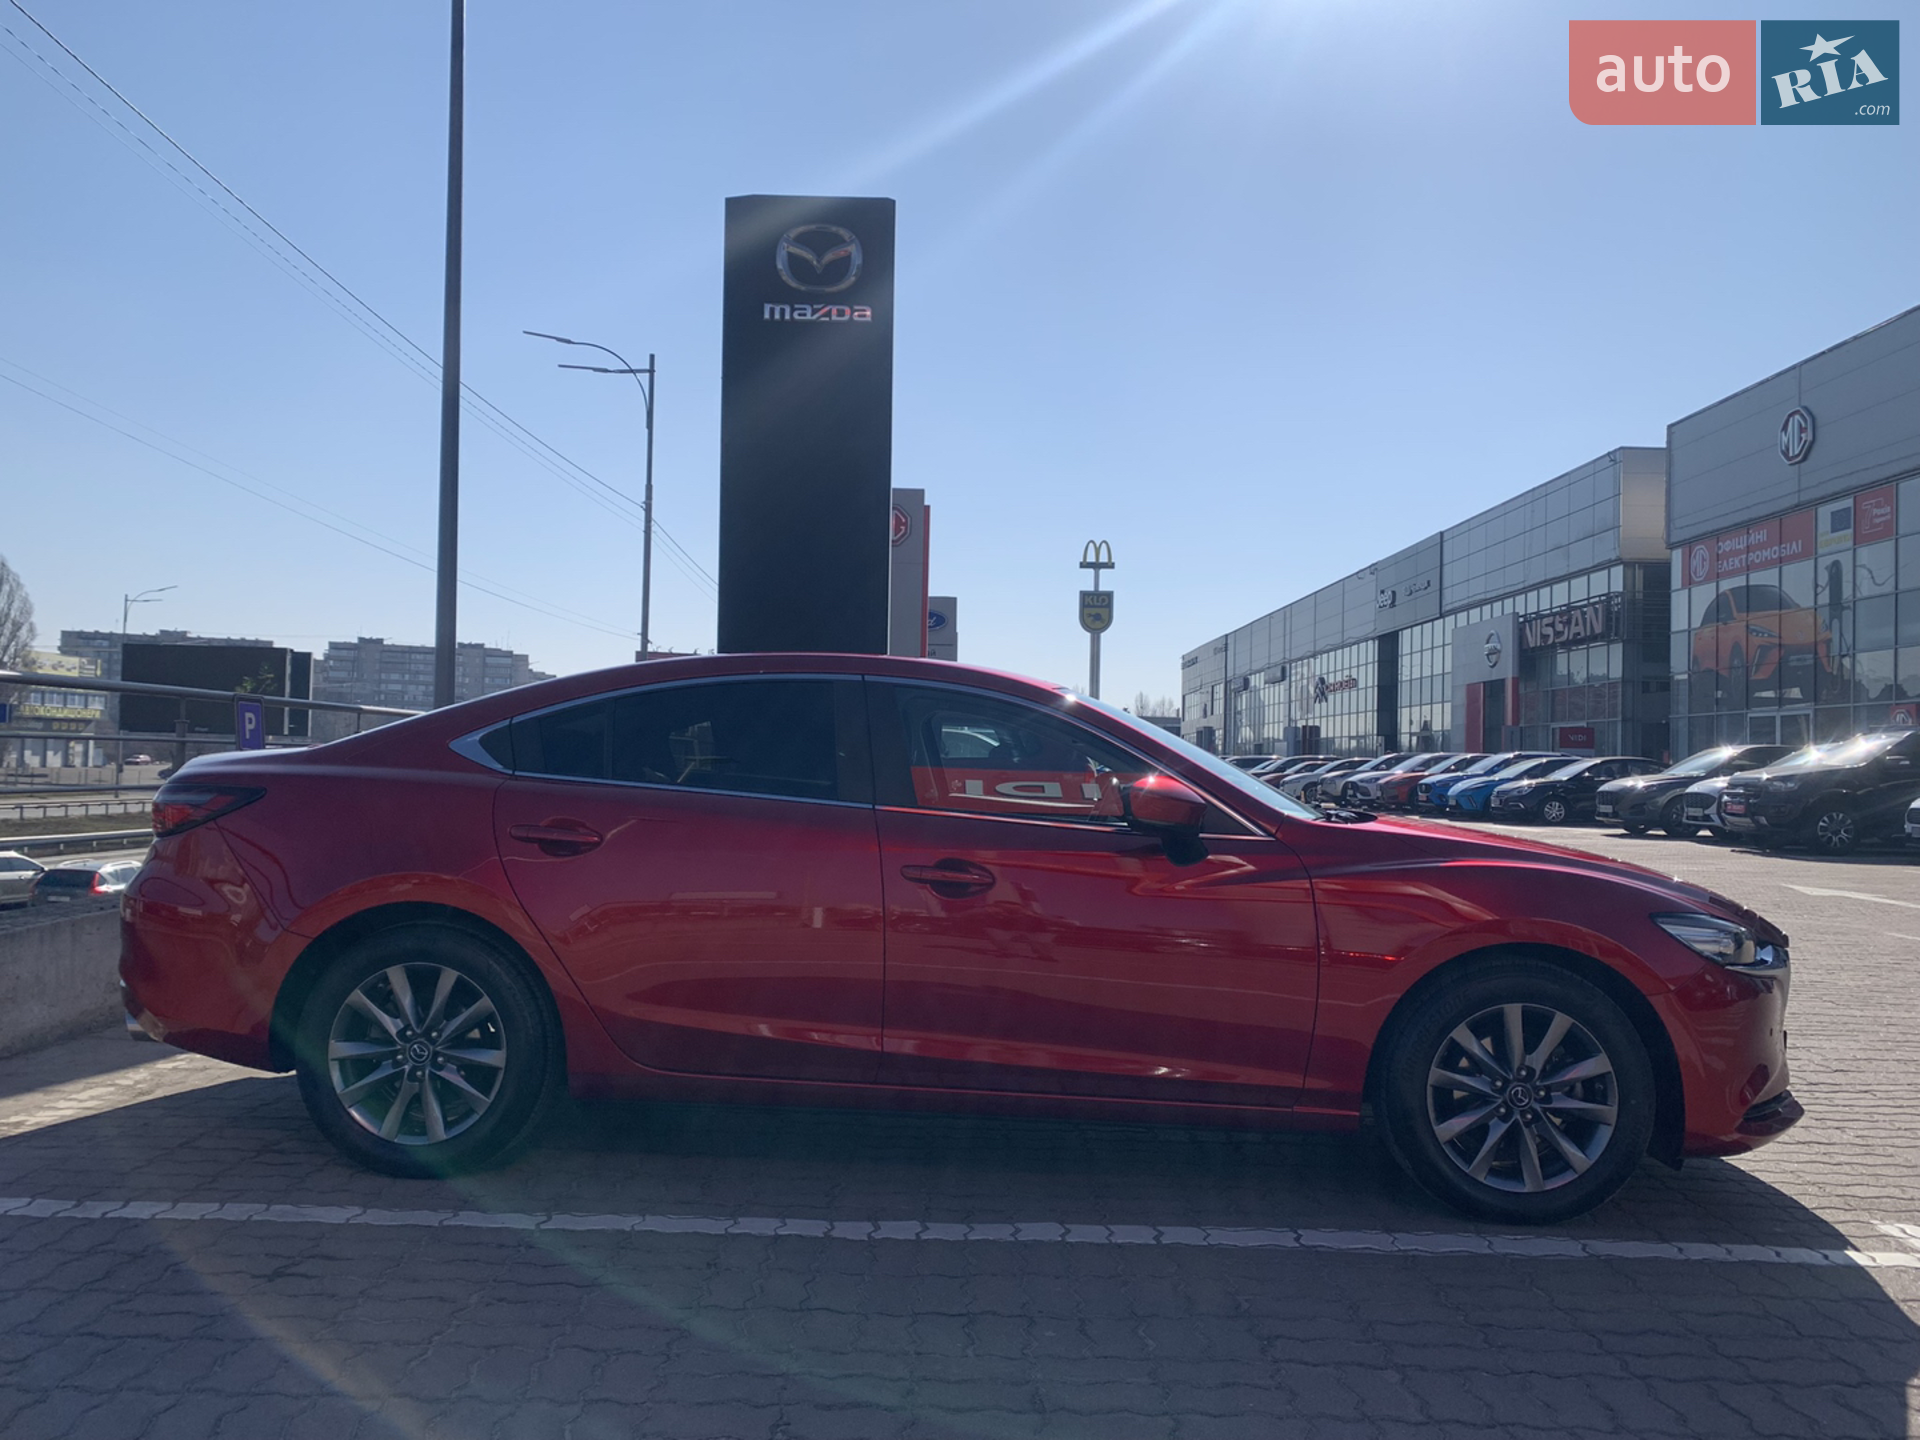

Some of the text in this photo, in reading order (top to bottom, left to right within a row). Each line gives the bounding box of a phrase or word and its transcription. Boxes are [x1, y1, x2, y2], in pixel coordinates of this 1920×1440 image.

[1781, 413, 1809, 458] MG
[1691, 547, 1708, 578] MG
[1085, 595, 1109, 606] KLO
[1523, 603, 1605, 648] NISSAN
[244, 711, 256, 739] P
